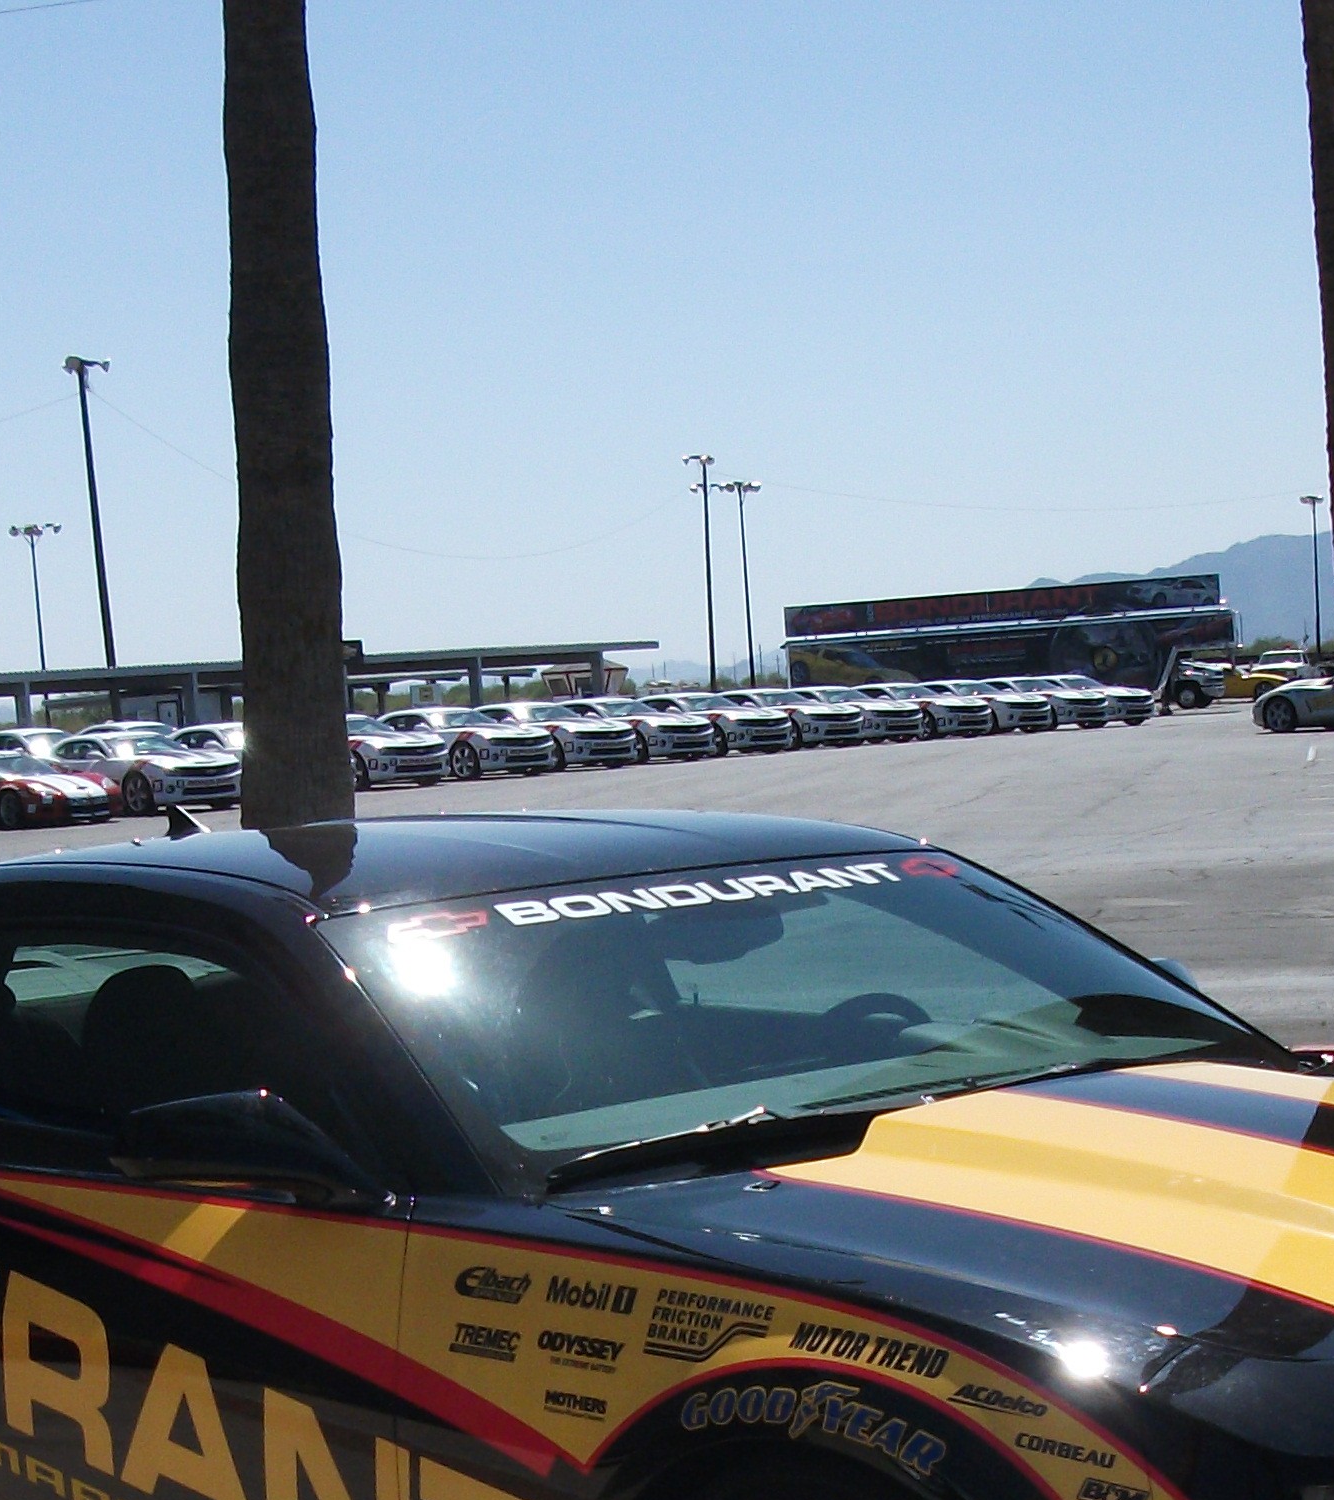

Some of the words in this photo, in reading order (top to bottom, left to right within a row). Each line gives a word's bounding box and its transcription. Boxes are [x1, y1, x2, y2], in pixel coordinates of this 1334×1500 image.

[491, 862, 903, 926] BONDURANT
[545, 1275, 613, 1311] Mobil
[611, 1285, 638, 1315] 1
[657, 1288, 776, 1322] PERFORMANCE
[651, 1305, 723, 1330] FRICTION
[454, 1322, 521, 1351] TREMEC
[537, 1330, 626, 1362] ODYSSEY
[647, 1323, 708, 1348] BRAKES
[788, 1322, 871, 1361] MOTOR
[867, 1335, 950, 1379] TREND
[544, 1389, 608, 1414] MOTHERS
[951, 1383, 1048, 1418] ACDelco
[1015, 1432, 1116, 1468] CORBEAU
